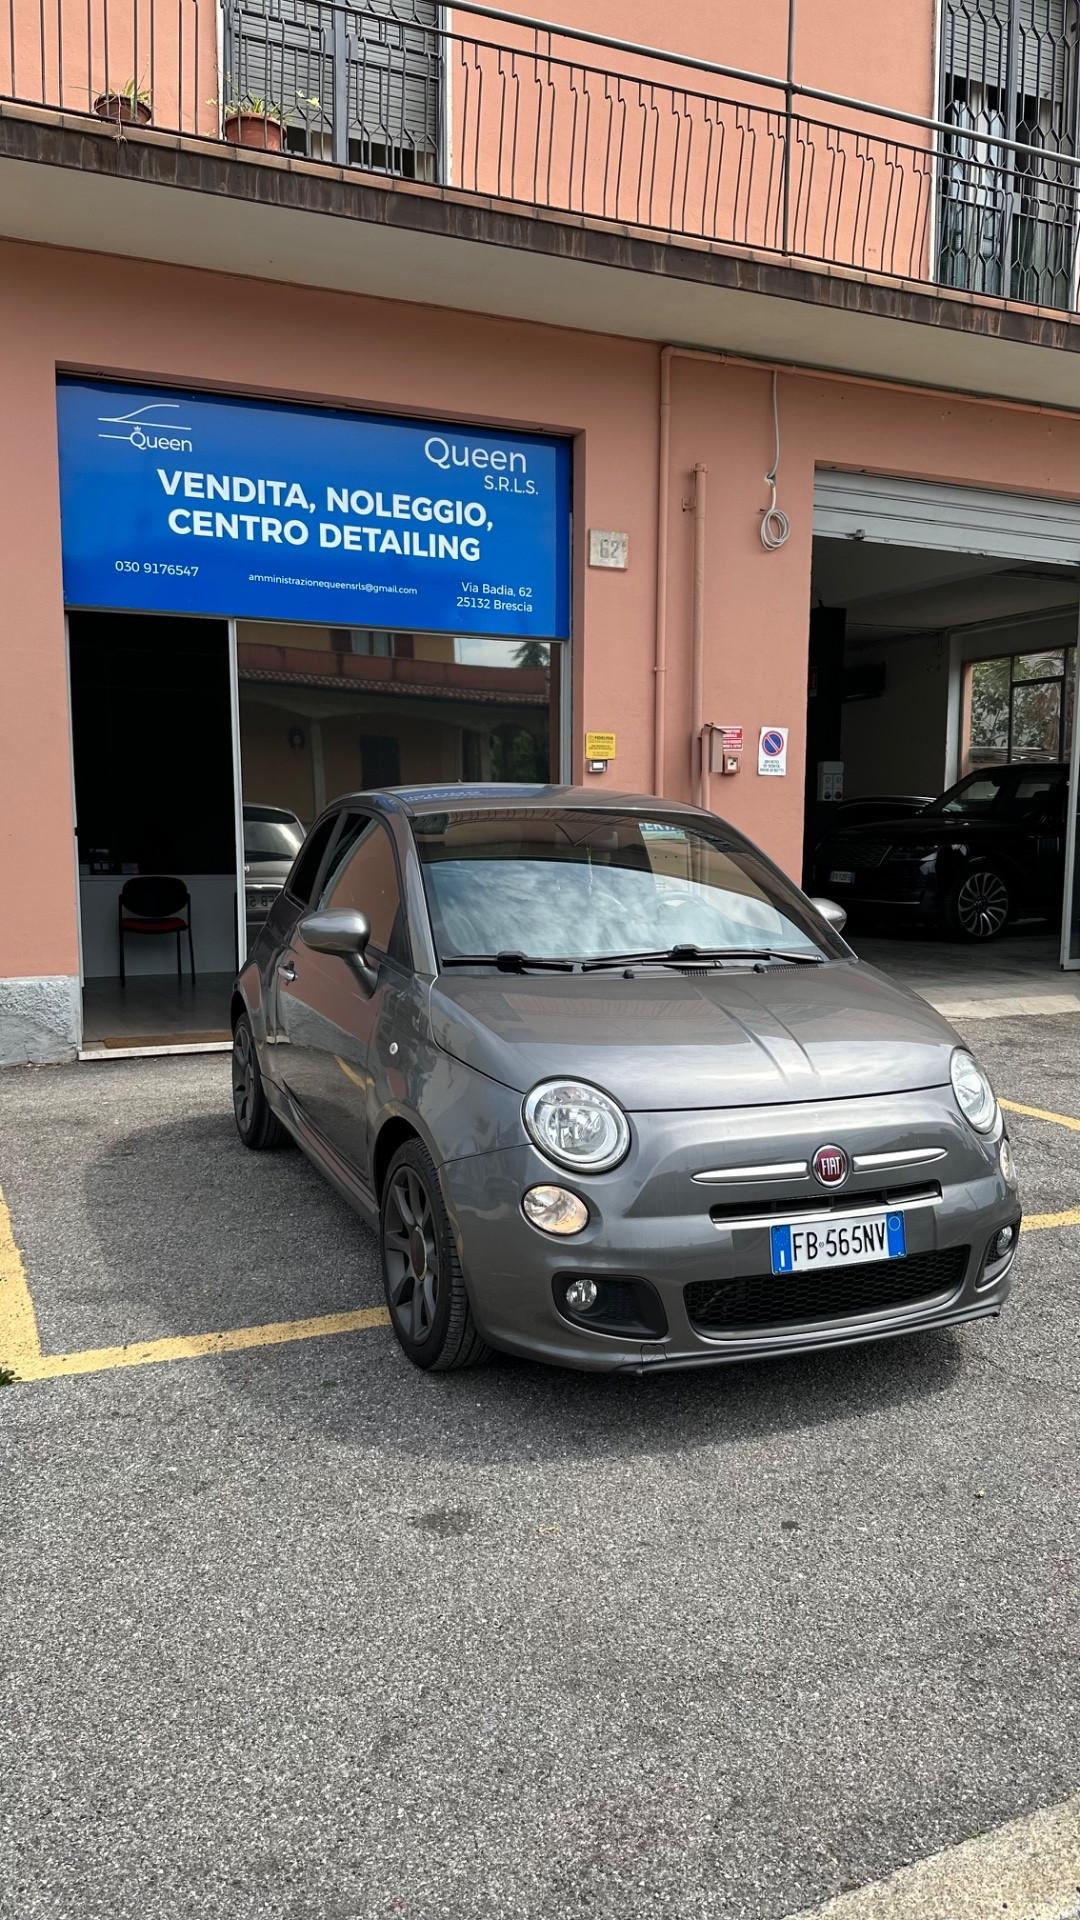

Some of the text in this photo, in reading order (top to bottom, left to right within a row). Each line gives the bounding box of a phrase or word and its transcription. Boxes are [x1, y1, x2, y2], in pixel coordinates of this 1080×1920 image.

[130, 431, 193, 452] Queen
[424, 437, 527, 473] Queen
[484, 475, 539, 495] S.R.L.S.
[157, 469, 494, 532] VENDITA, NOLEGGIO,
[168, 508, 481, 562] CENTRO DETAILING
[115, 560, 199, 577] 030 9176547
[248, 573, 418, 595] amministrazionequeensrls@gmail.com
[461, 581, 533, 598] Via Badia, 62
[456, 596, 533, 613] 25132 Brescia
[821, 1156, 841, 1176] FIAT
